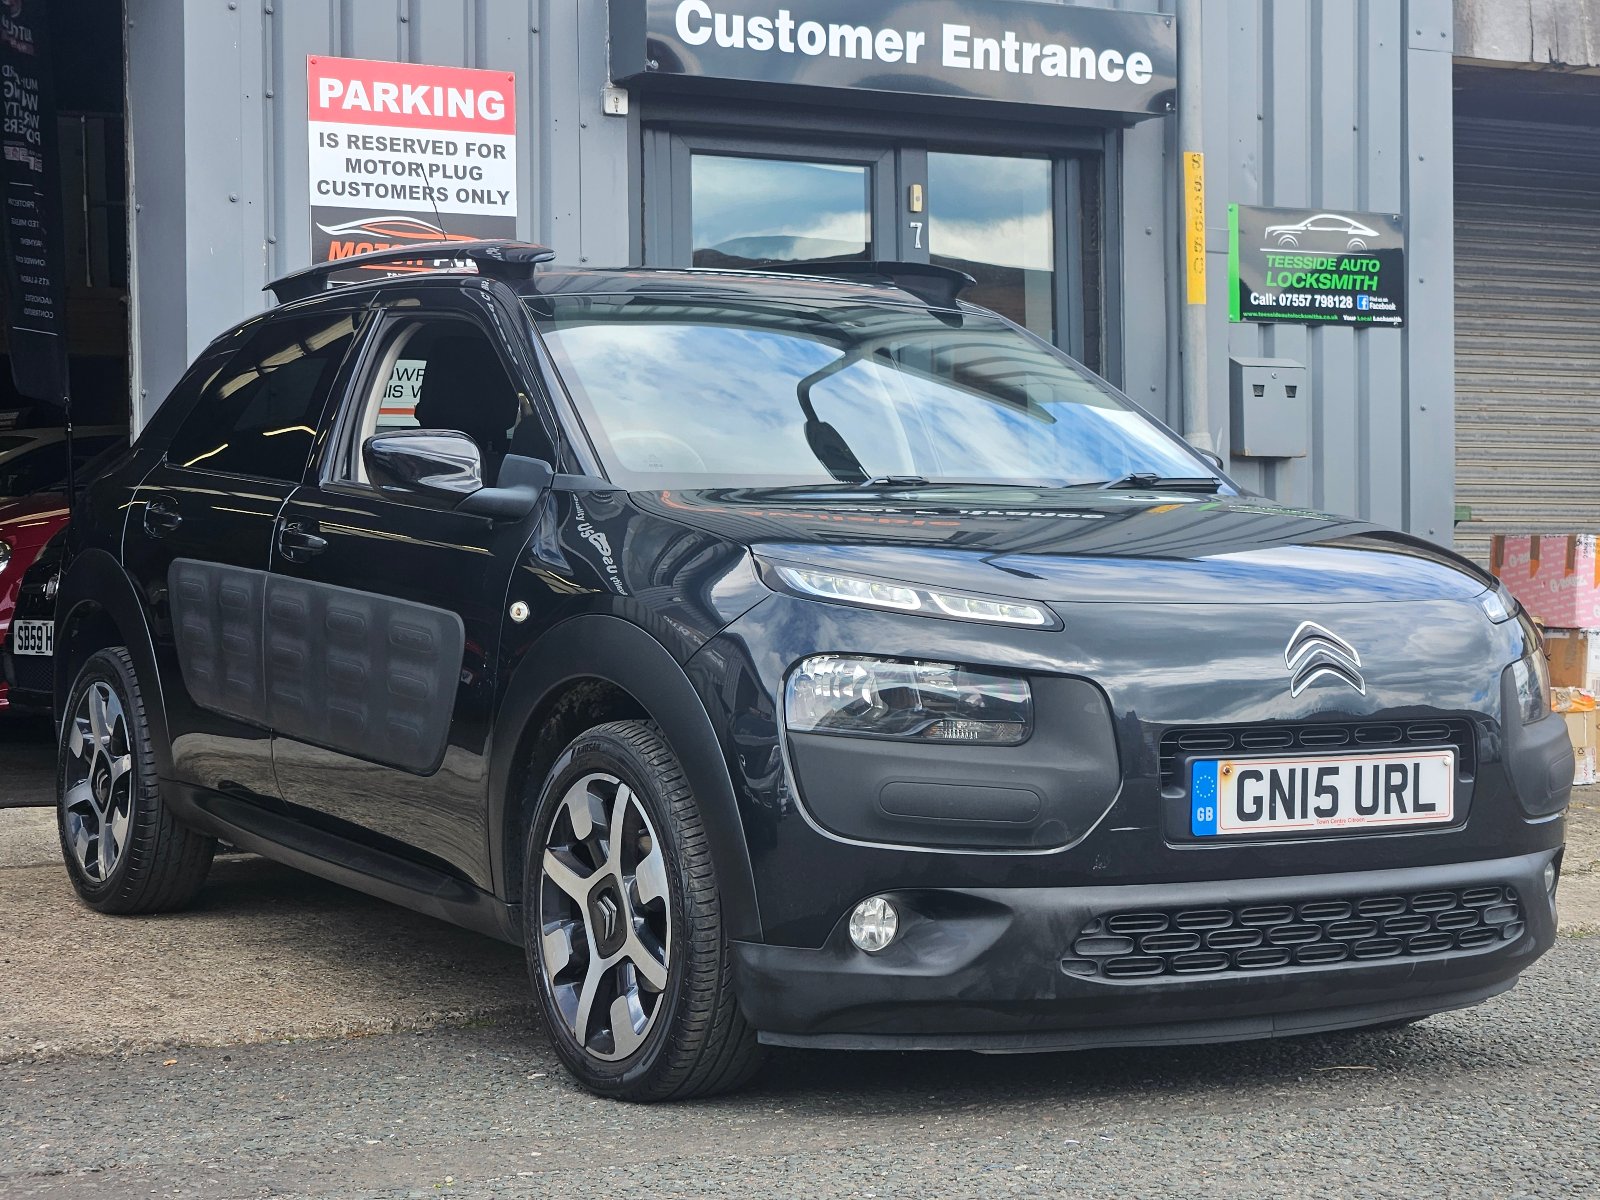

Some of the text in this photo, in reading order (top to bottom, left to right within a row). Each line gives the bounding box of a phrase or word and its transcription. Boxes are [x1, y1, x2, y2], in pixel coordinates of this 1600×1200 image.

[675, 0, 1153, 86] Customer Entrance
[319, 77, 505, 121] PARKING
[319, 132, 506, 159] IS RESERVED FOR
[345, 158, 483, 181] MOTOR PLUG
[317, 180, 510, 205] CUSTOMERS ONLY
[909, 221, 922, 250] 7
[1266, 255, 1380, 273] TEESSIDE AUTO
[1266, 271, 1378, 291] LOCKSMITH
[1250, 292, 1353, 309] Call: 07557 798128
[1369, 302, 1396, 311] Facebook
[1373, 315, 1402, 323] Locksmith
[18, 625, 43, 651] SB59
[1236, 762, 1436, 821] GN15 URL
[1196, 807, 1213, 822] GB
